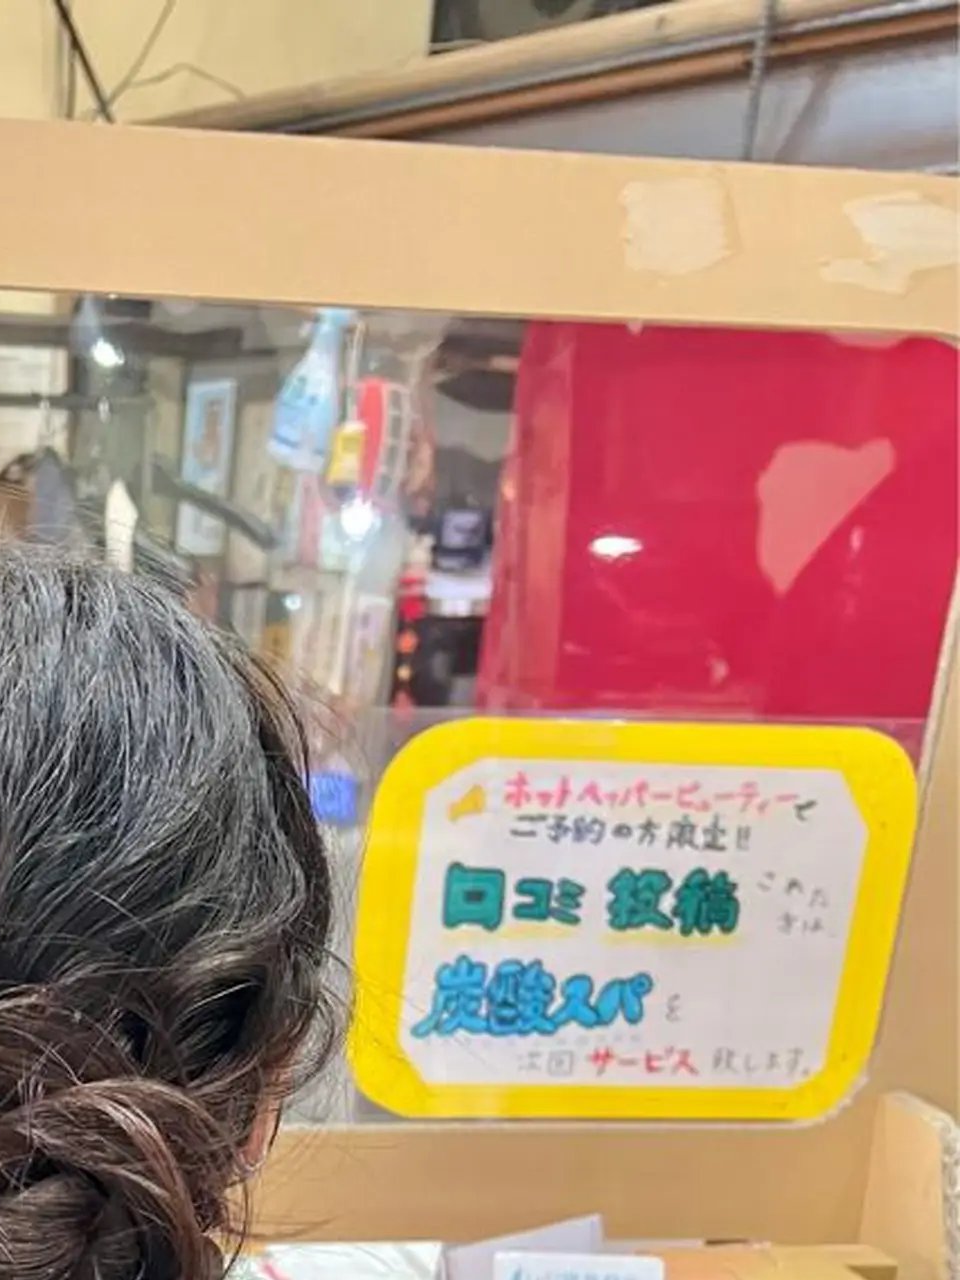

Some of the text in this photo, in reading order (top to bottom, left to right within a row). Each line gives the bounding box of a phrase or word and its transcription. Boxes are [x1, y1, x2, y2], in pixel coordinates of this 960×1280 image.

[442, 861, 586, 931] 口コミ
[606, 866, 740, 936] 投稿
[410, 953, 655, 1038] 炭酸スパ
[585, 1045, 700, 1078] サービス
